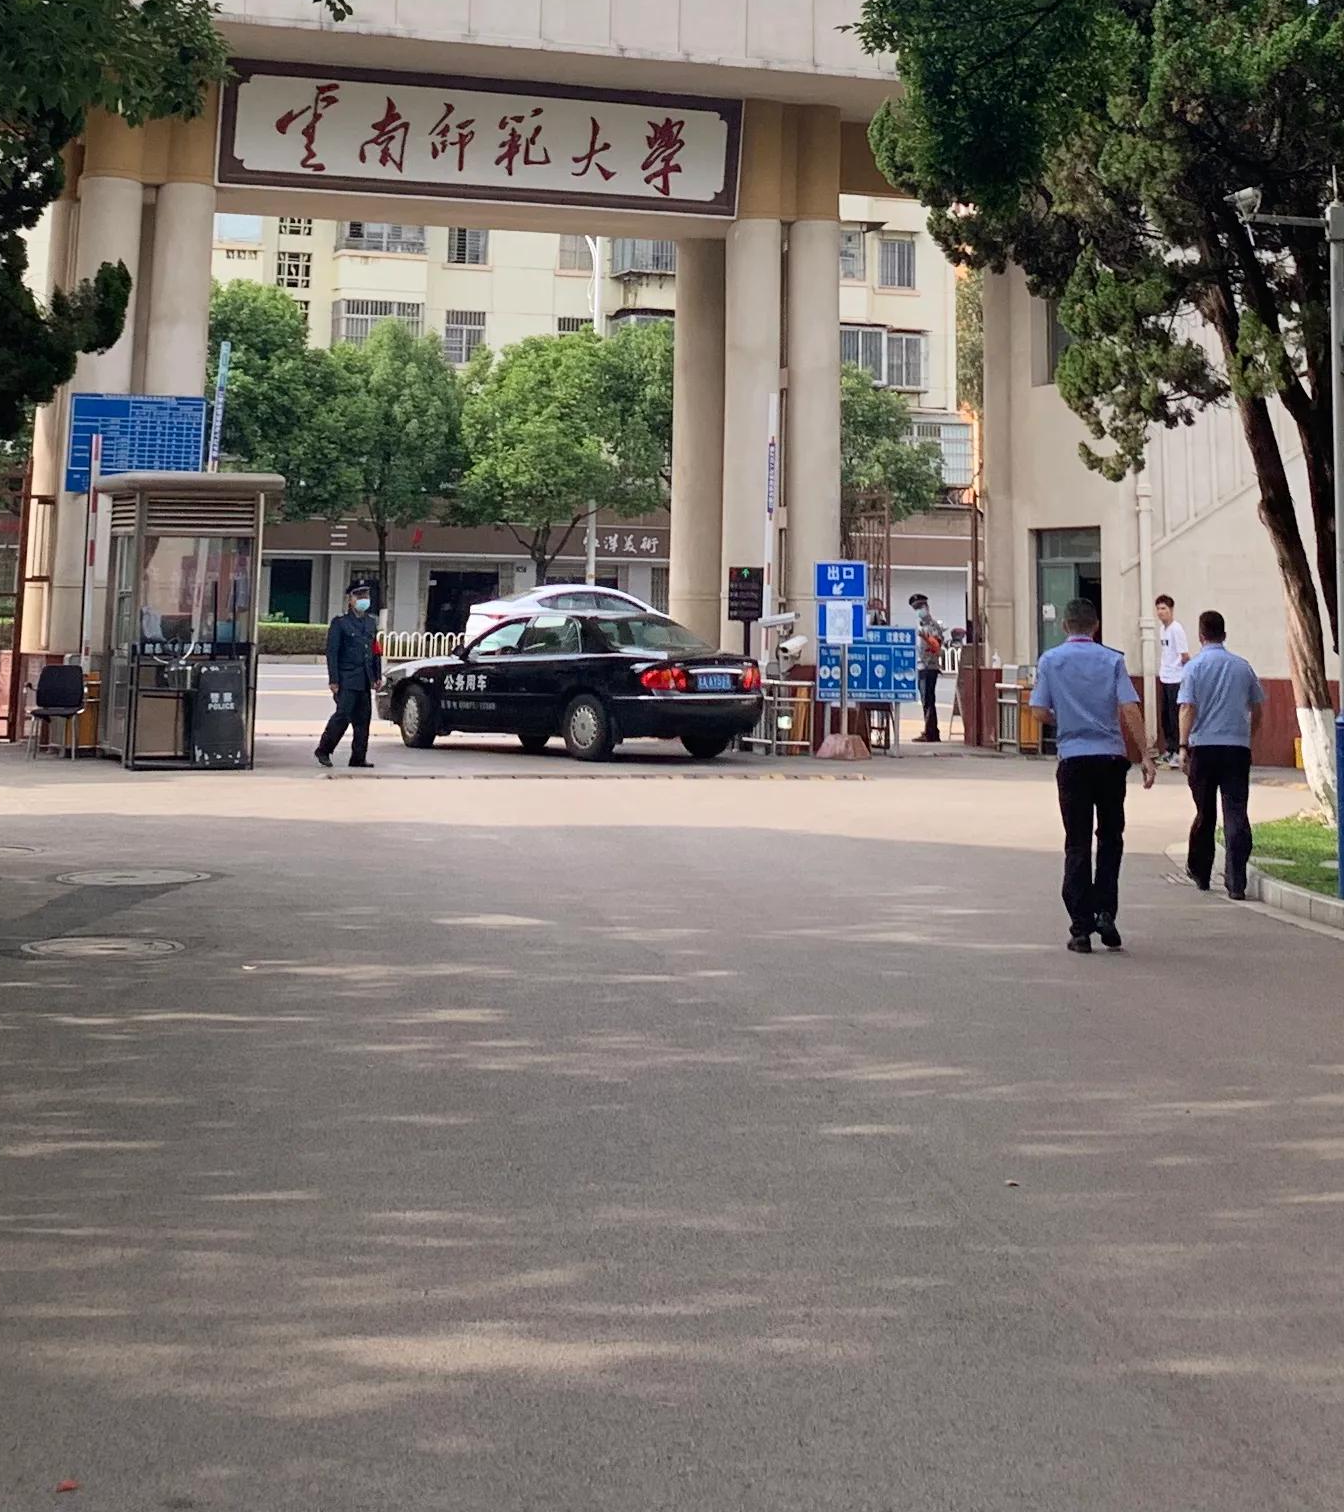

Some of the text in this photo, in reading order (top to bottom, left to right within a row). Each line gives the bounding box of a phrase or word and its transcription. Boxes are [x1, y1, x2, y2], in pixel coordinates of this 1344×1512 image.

[827, 566, 855, 581] 出口
[444, 673, 488, 692] 公务用车
[208, 702, 235, 711] POLICE
